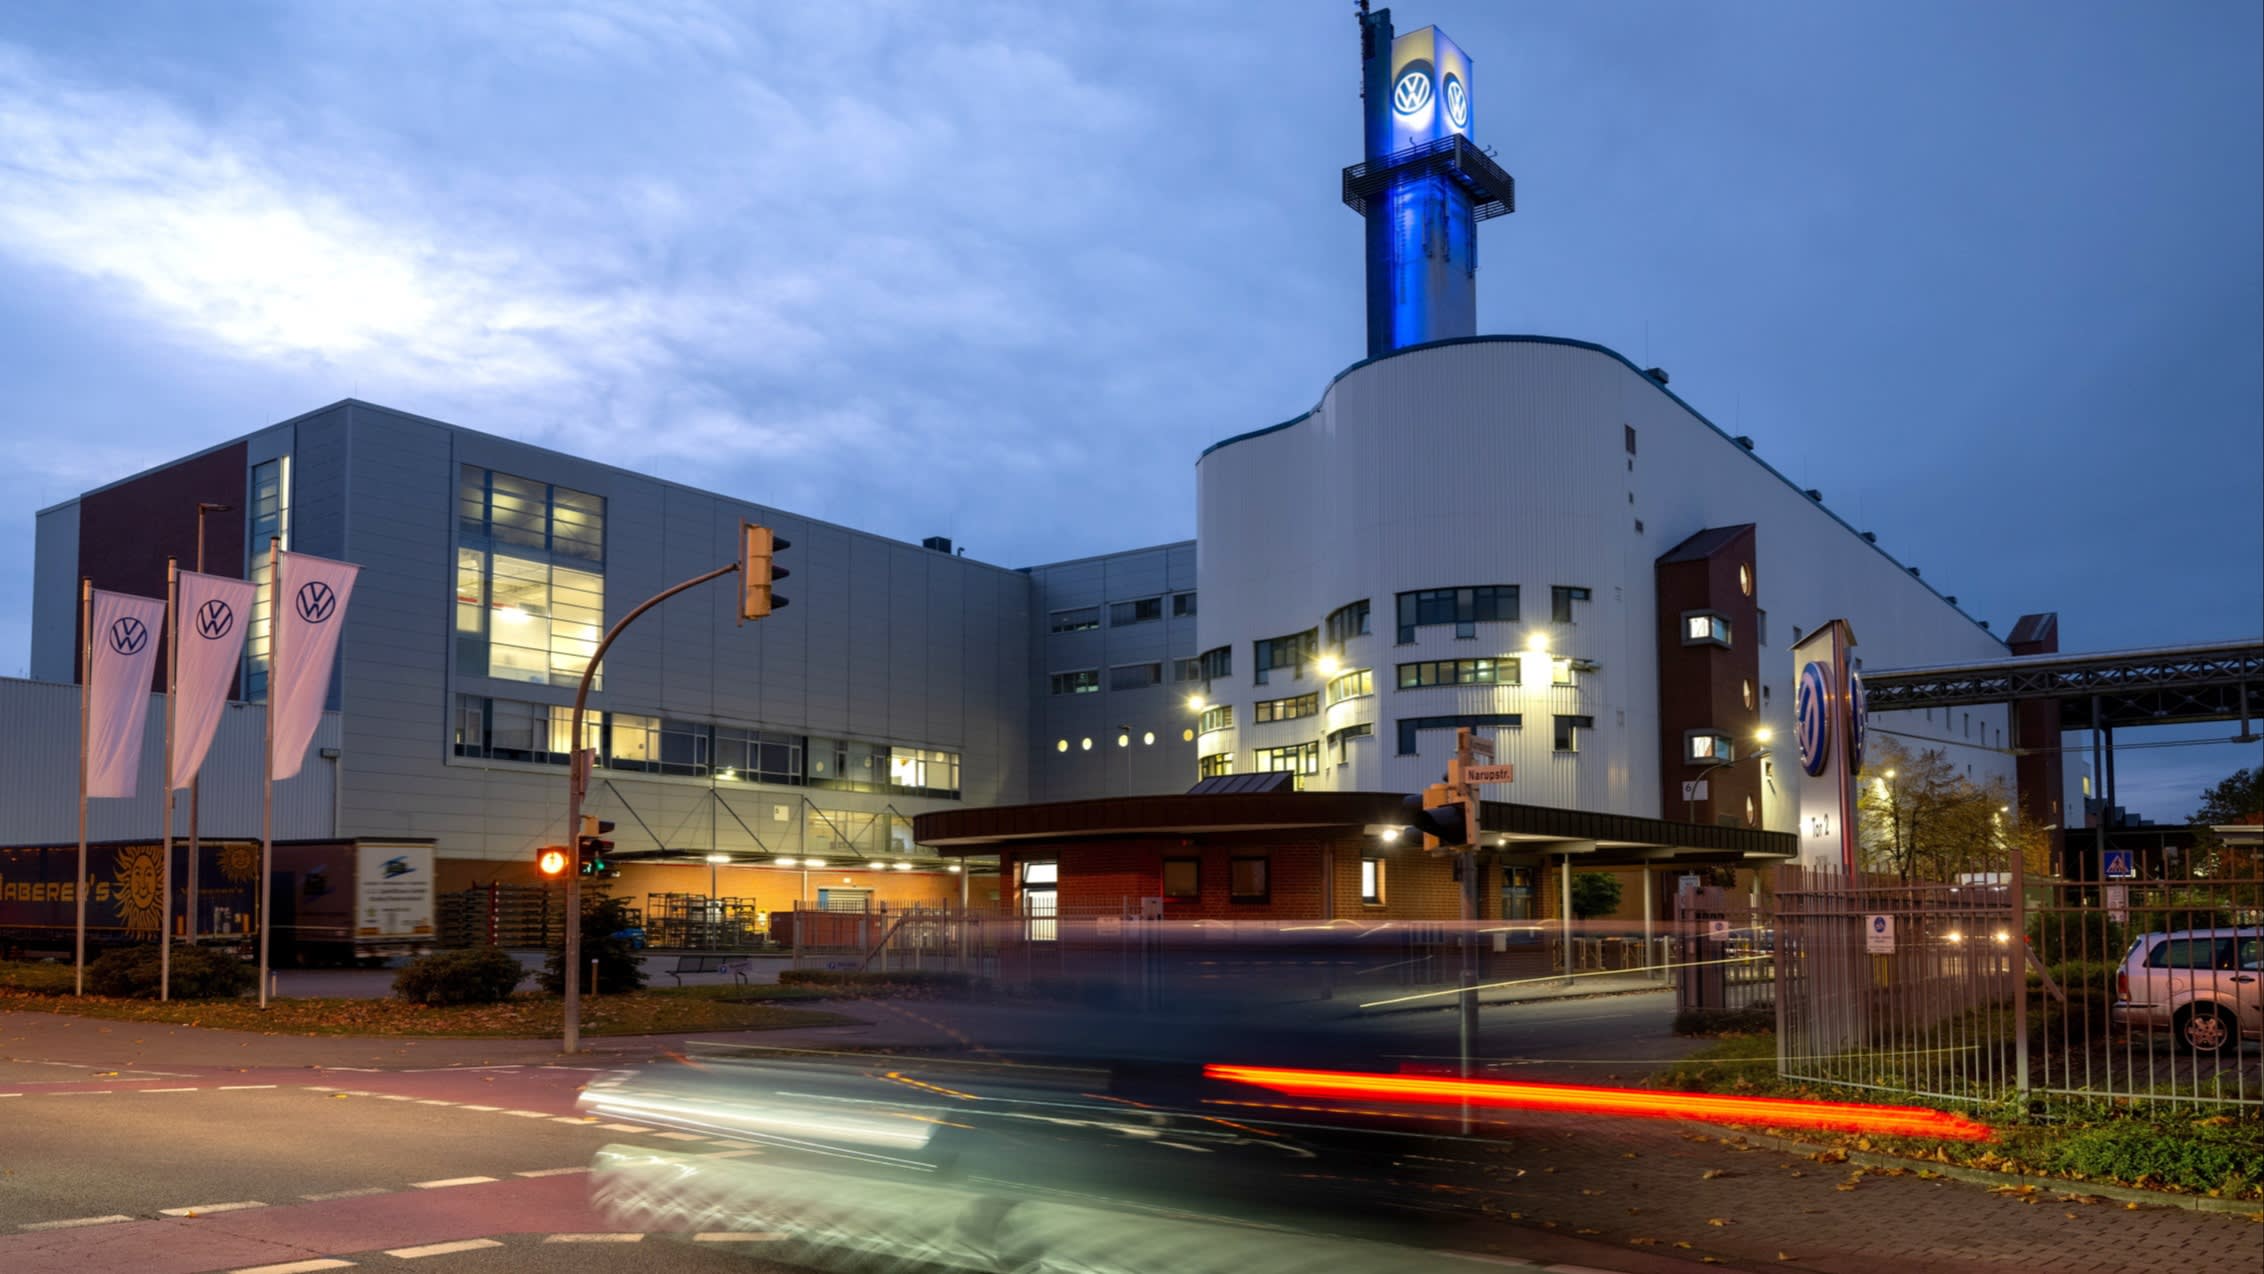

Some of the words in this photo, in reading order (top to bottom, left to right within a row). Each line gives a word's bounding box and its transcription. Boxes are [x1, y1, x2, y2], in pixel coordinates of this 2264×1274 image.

[1395, 73, 1430, 112] VW
[1448, 82, 1468, 126] VW
[196, 600, 233, 639] VW
[296, 582, 336, 623] VW
[110, 617, 147, 655] VW
[1468, 769, 1510, 781] Narupstr.
[1811, 817, 1823, 838] Tor
[1824, 813, 1830, 836] 2
